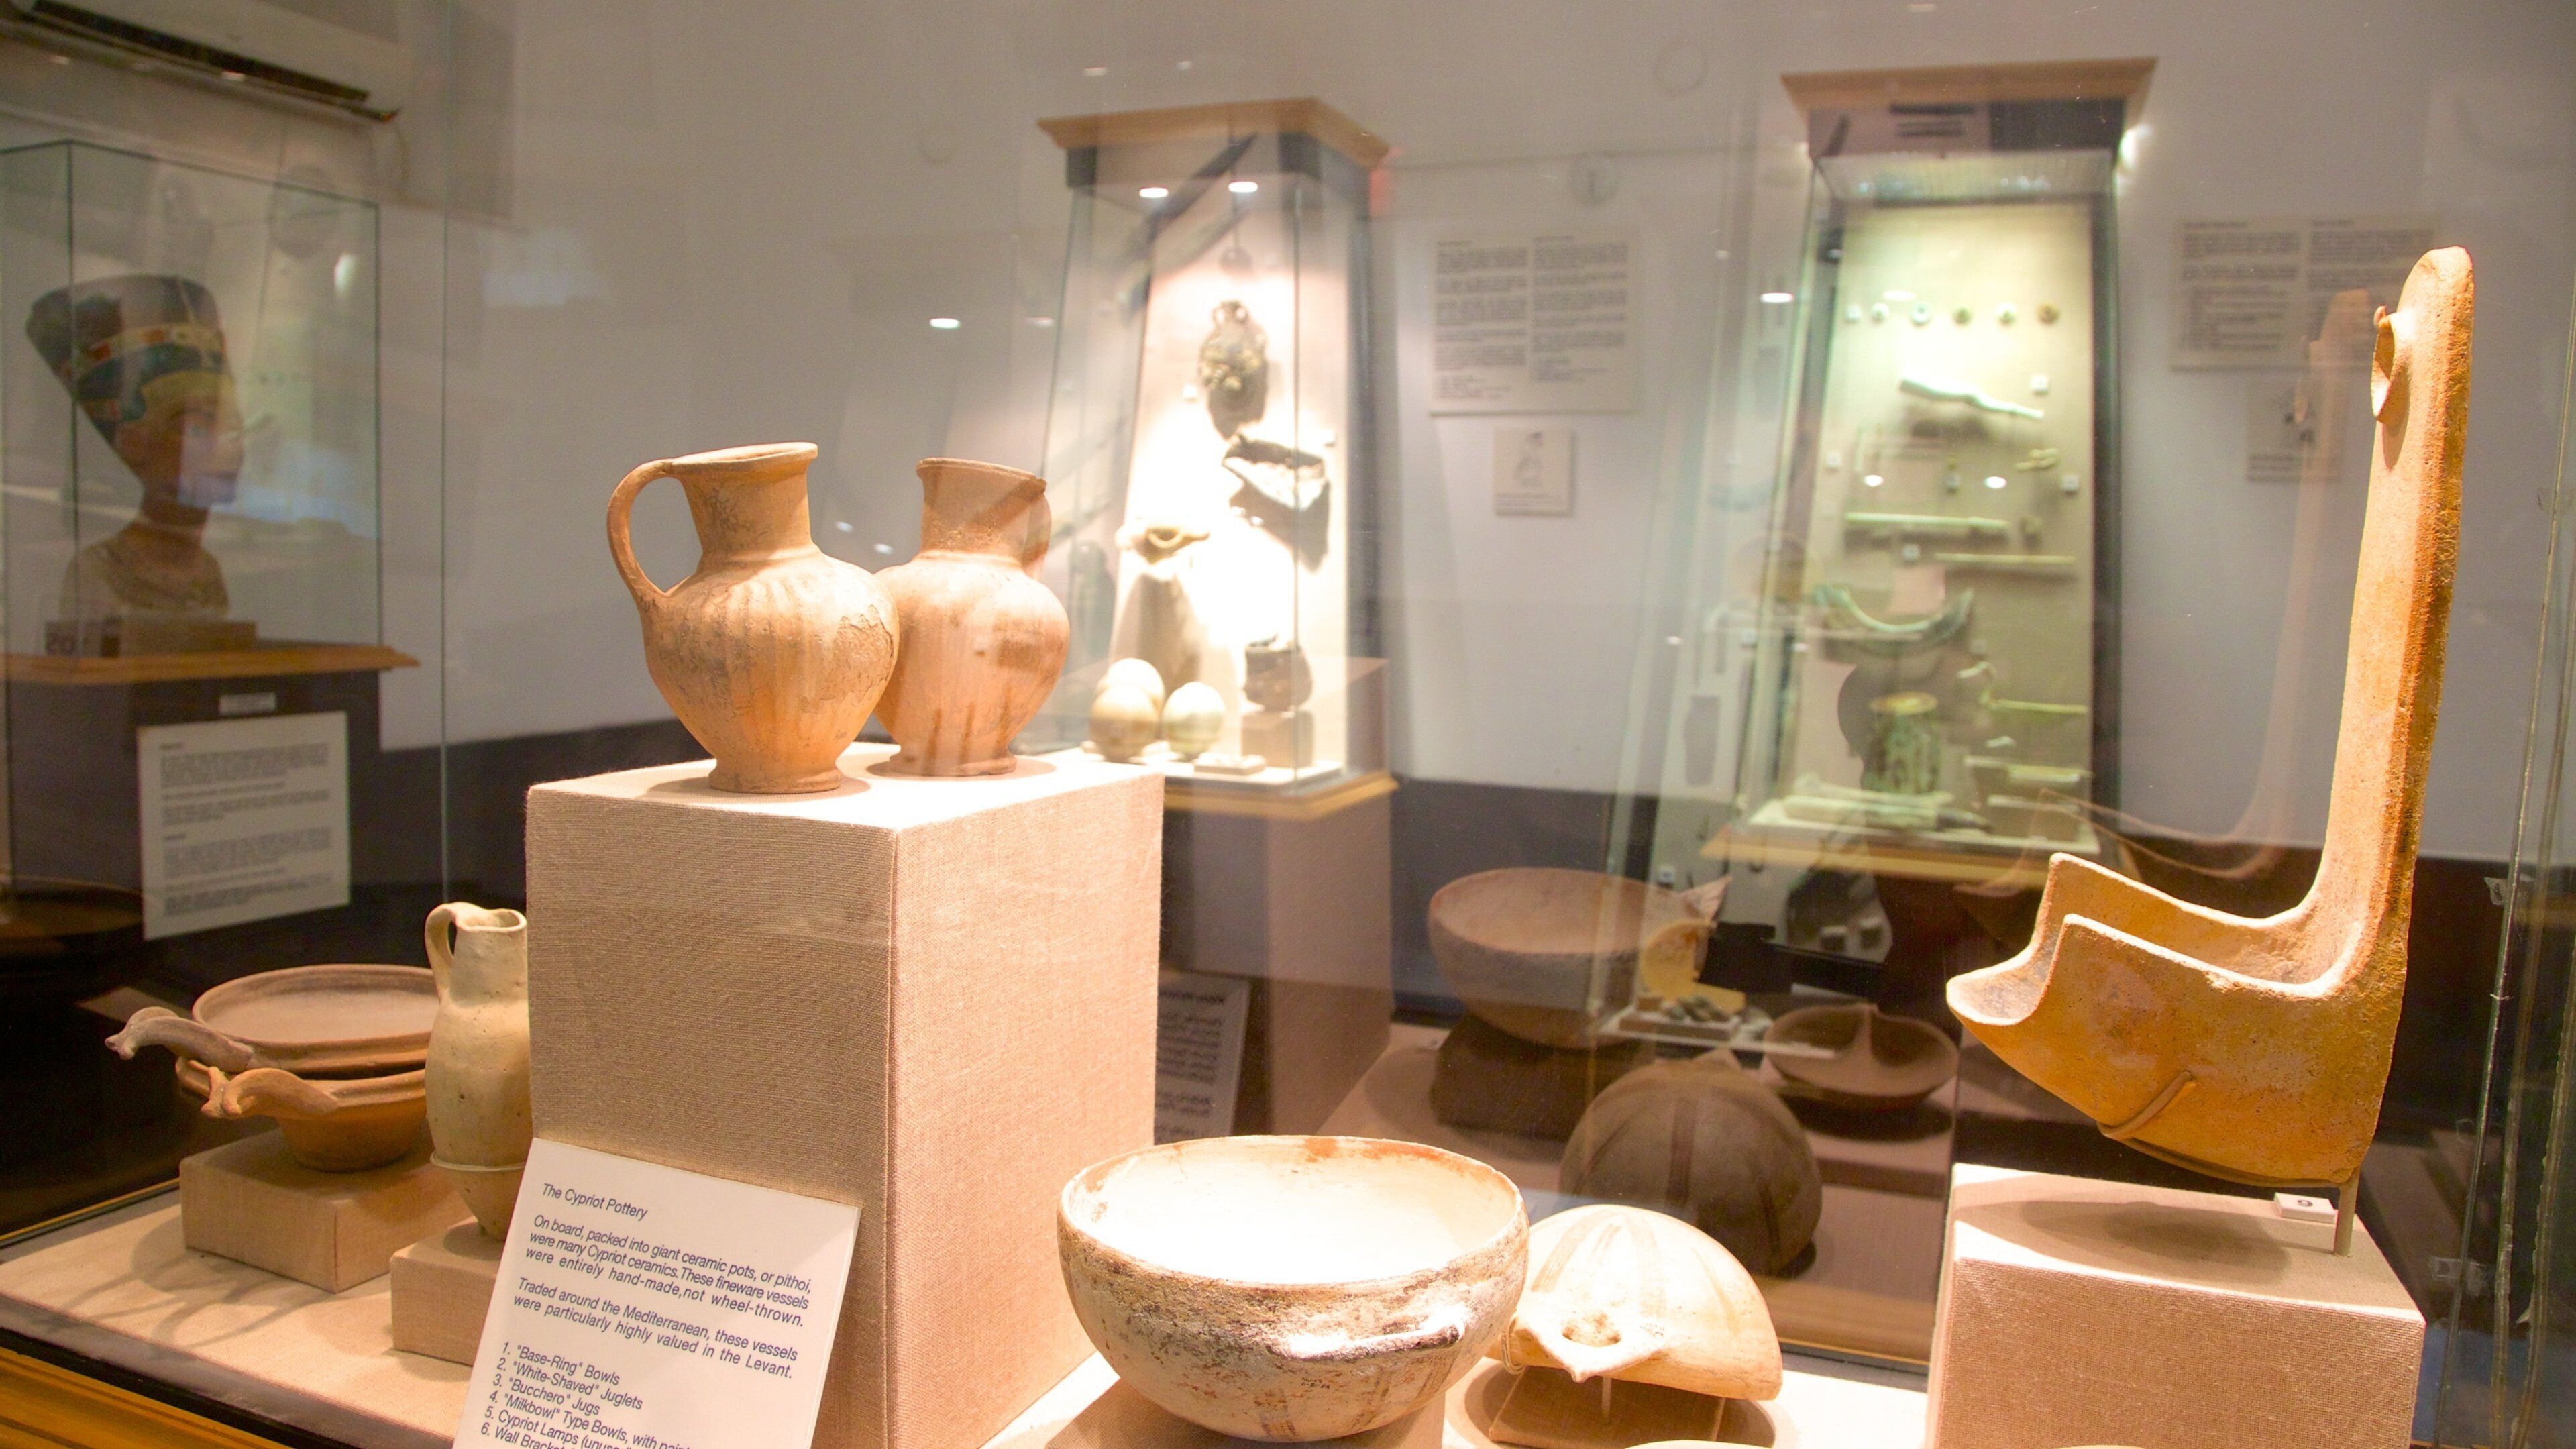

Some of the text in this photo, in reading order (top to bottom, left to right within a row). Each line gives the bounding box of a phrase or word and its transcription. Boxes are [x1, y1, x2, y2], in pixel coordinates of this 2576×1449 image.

[543, 1183, 648, 1221] The Cypriot Pottery
[530, 1233, 555, 1247] were
[556, 1240, 586, 1257] many
[588, 1244, 627, 1265] Cypriot
[715, 1275, 764, 1299] fineware
[767, 1291, 809, 1309] vessels
[534, 1215, 811, 1295] On board, packed into giant ceramic pots, or pithoi,
[526, 1248, 553, 1264] were
[559, 1257, 604, 1279] entirely
[711, 1295, 804, 1326] wheel-thrown.
[514, 1295, 792, 1379] were particularly highly valued in the Levant.
[518, 1277, 798, 1361] Traded around the Mediterranean, these vessels
[497, 1357, 643, 1410] 2. "White-Shaved" Juglets
[502, 1342, 620, 1385] 1. "Base-Ring" Bowls
[489, 1391, 498, 1403] 4.
[504, 1393, 561, 1419] "Milkbowl"
[563, 1411, 589, 1430] Type
[591, 1419, 628, 1443] Bowls,
[633, 1434, 657, 1449] with
[493, 1373, 600, 1416] 3. "Bucchero" Jugs
[480, 1422, 490, 1436] 6.
[494, 1426, 519, 1444] Wall
[484, 1405, 494, 1419] 5.
[498, 1409, 539, 1433] Cypriot
[540, 1422, 579, 1445] Lamps
